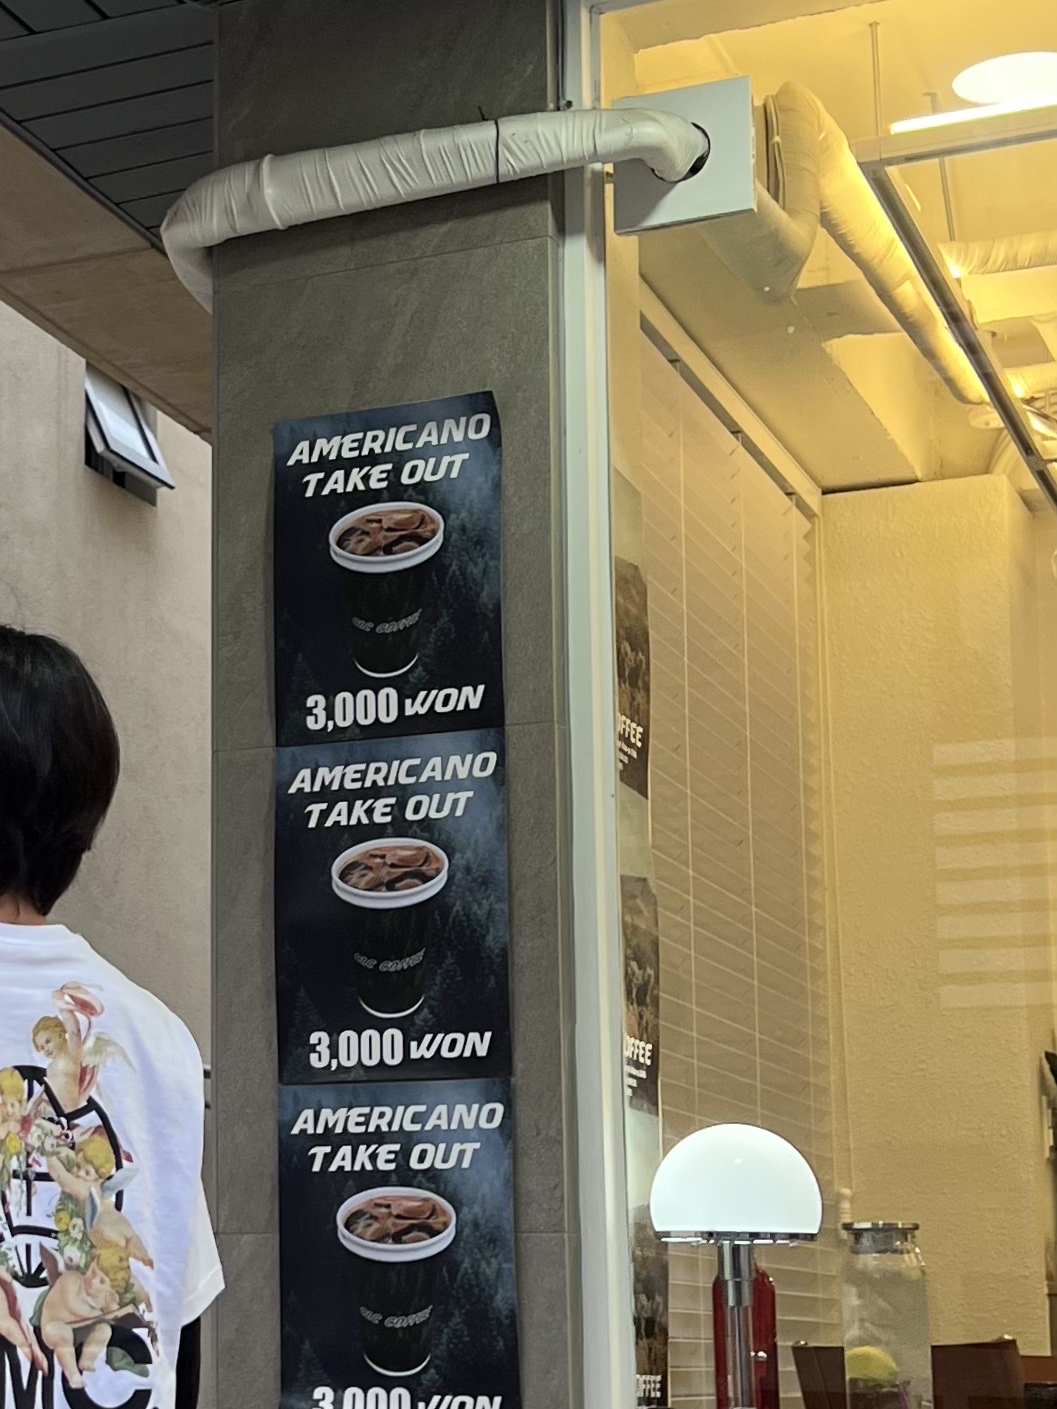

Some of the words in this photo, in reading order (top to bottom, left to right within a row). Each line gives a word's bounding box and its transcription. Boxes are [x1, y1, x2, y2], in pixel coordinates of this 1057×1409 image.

[286, 412, 491, 467] AMERICANO
[301, 463, 393, 498] TAKE
[400, 453, 470, 485] OUT
[305, 687, 398, 732] 3,000
[404, 684, 485, 717] WON
[287, 751, 497, 794] AMERICANO
[303, 796, 397, 829] TAKE
[404, 791, 475, 822] OUT
[308, 1027, 403, 1071] 3,000
[409, 1031, 492, 1059] WON
[290, 1102, 505, 1135] AMERICANO
[307, 1143, 401, 1173] TAKE
[408, 1142, 481, 1171] OUT
